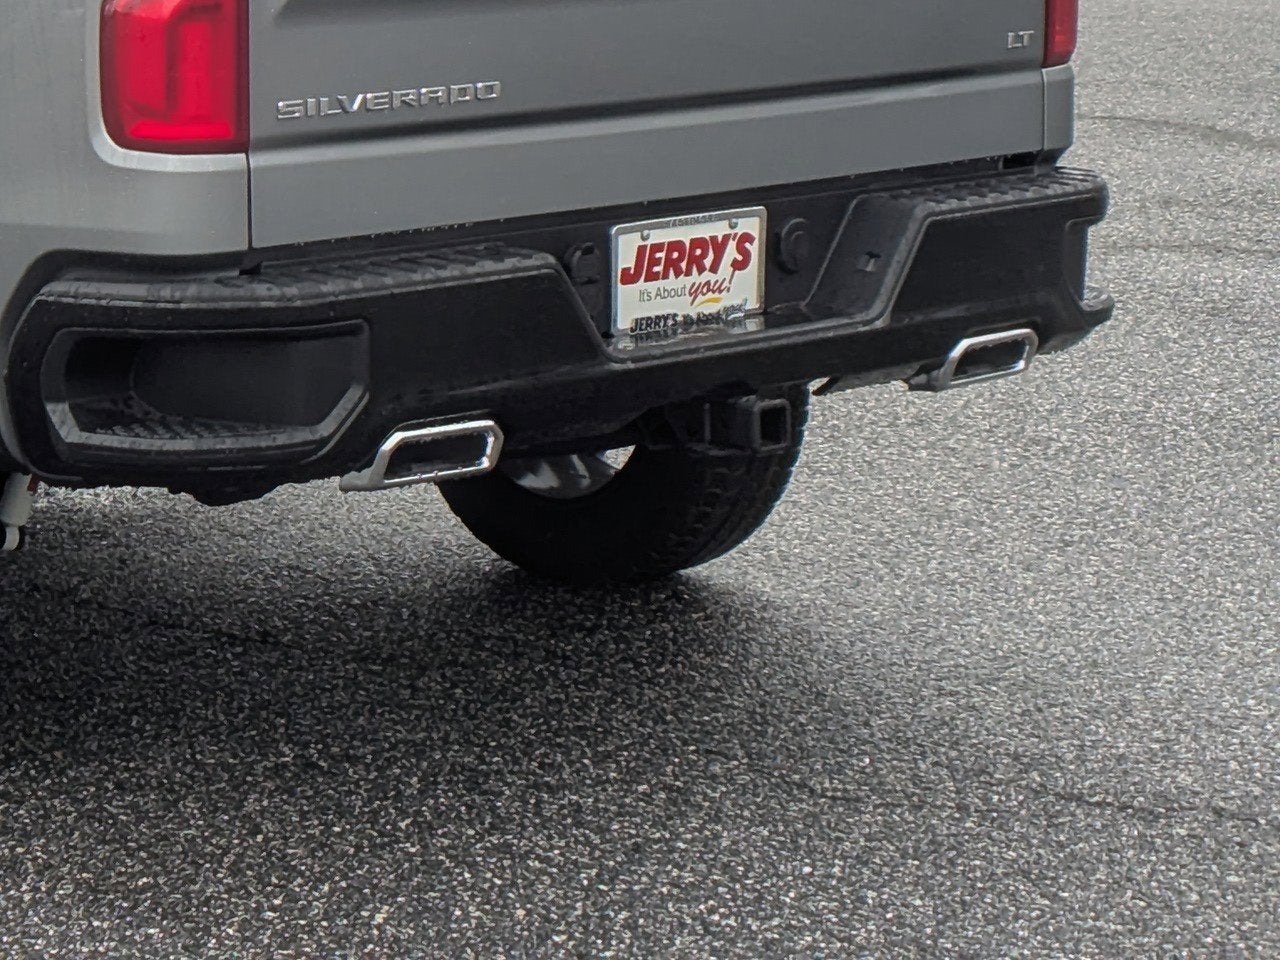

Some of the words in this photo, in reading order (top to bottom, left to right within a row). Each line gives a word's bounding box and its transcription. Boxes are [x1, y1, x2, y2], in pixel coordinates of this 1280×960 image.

[1007, 30, 1035, 49] LT
[276, 81, 501, 119] SILVERADO
[620, 232, 756, 285] JERRY'S
[638, 287, 653, 302] It's
[654, 283, 687, 300] About
